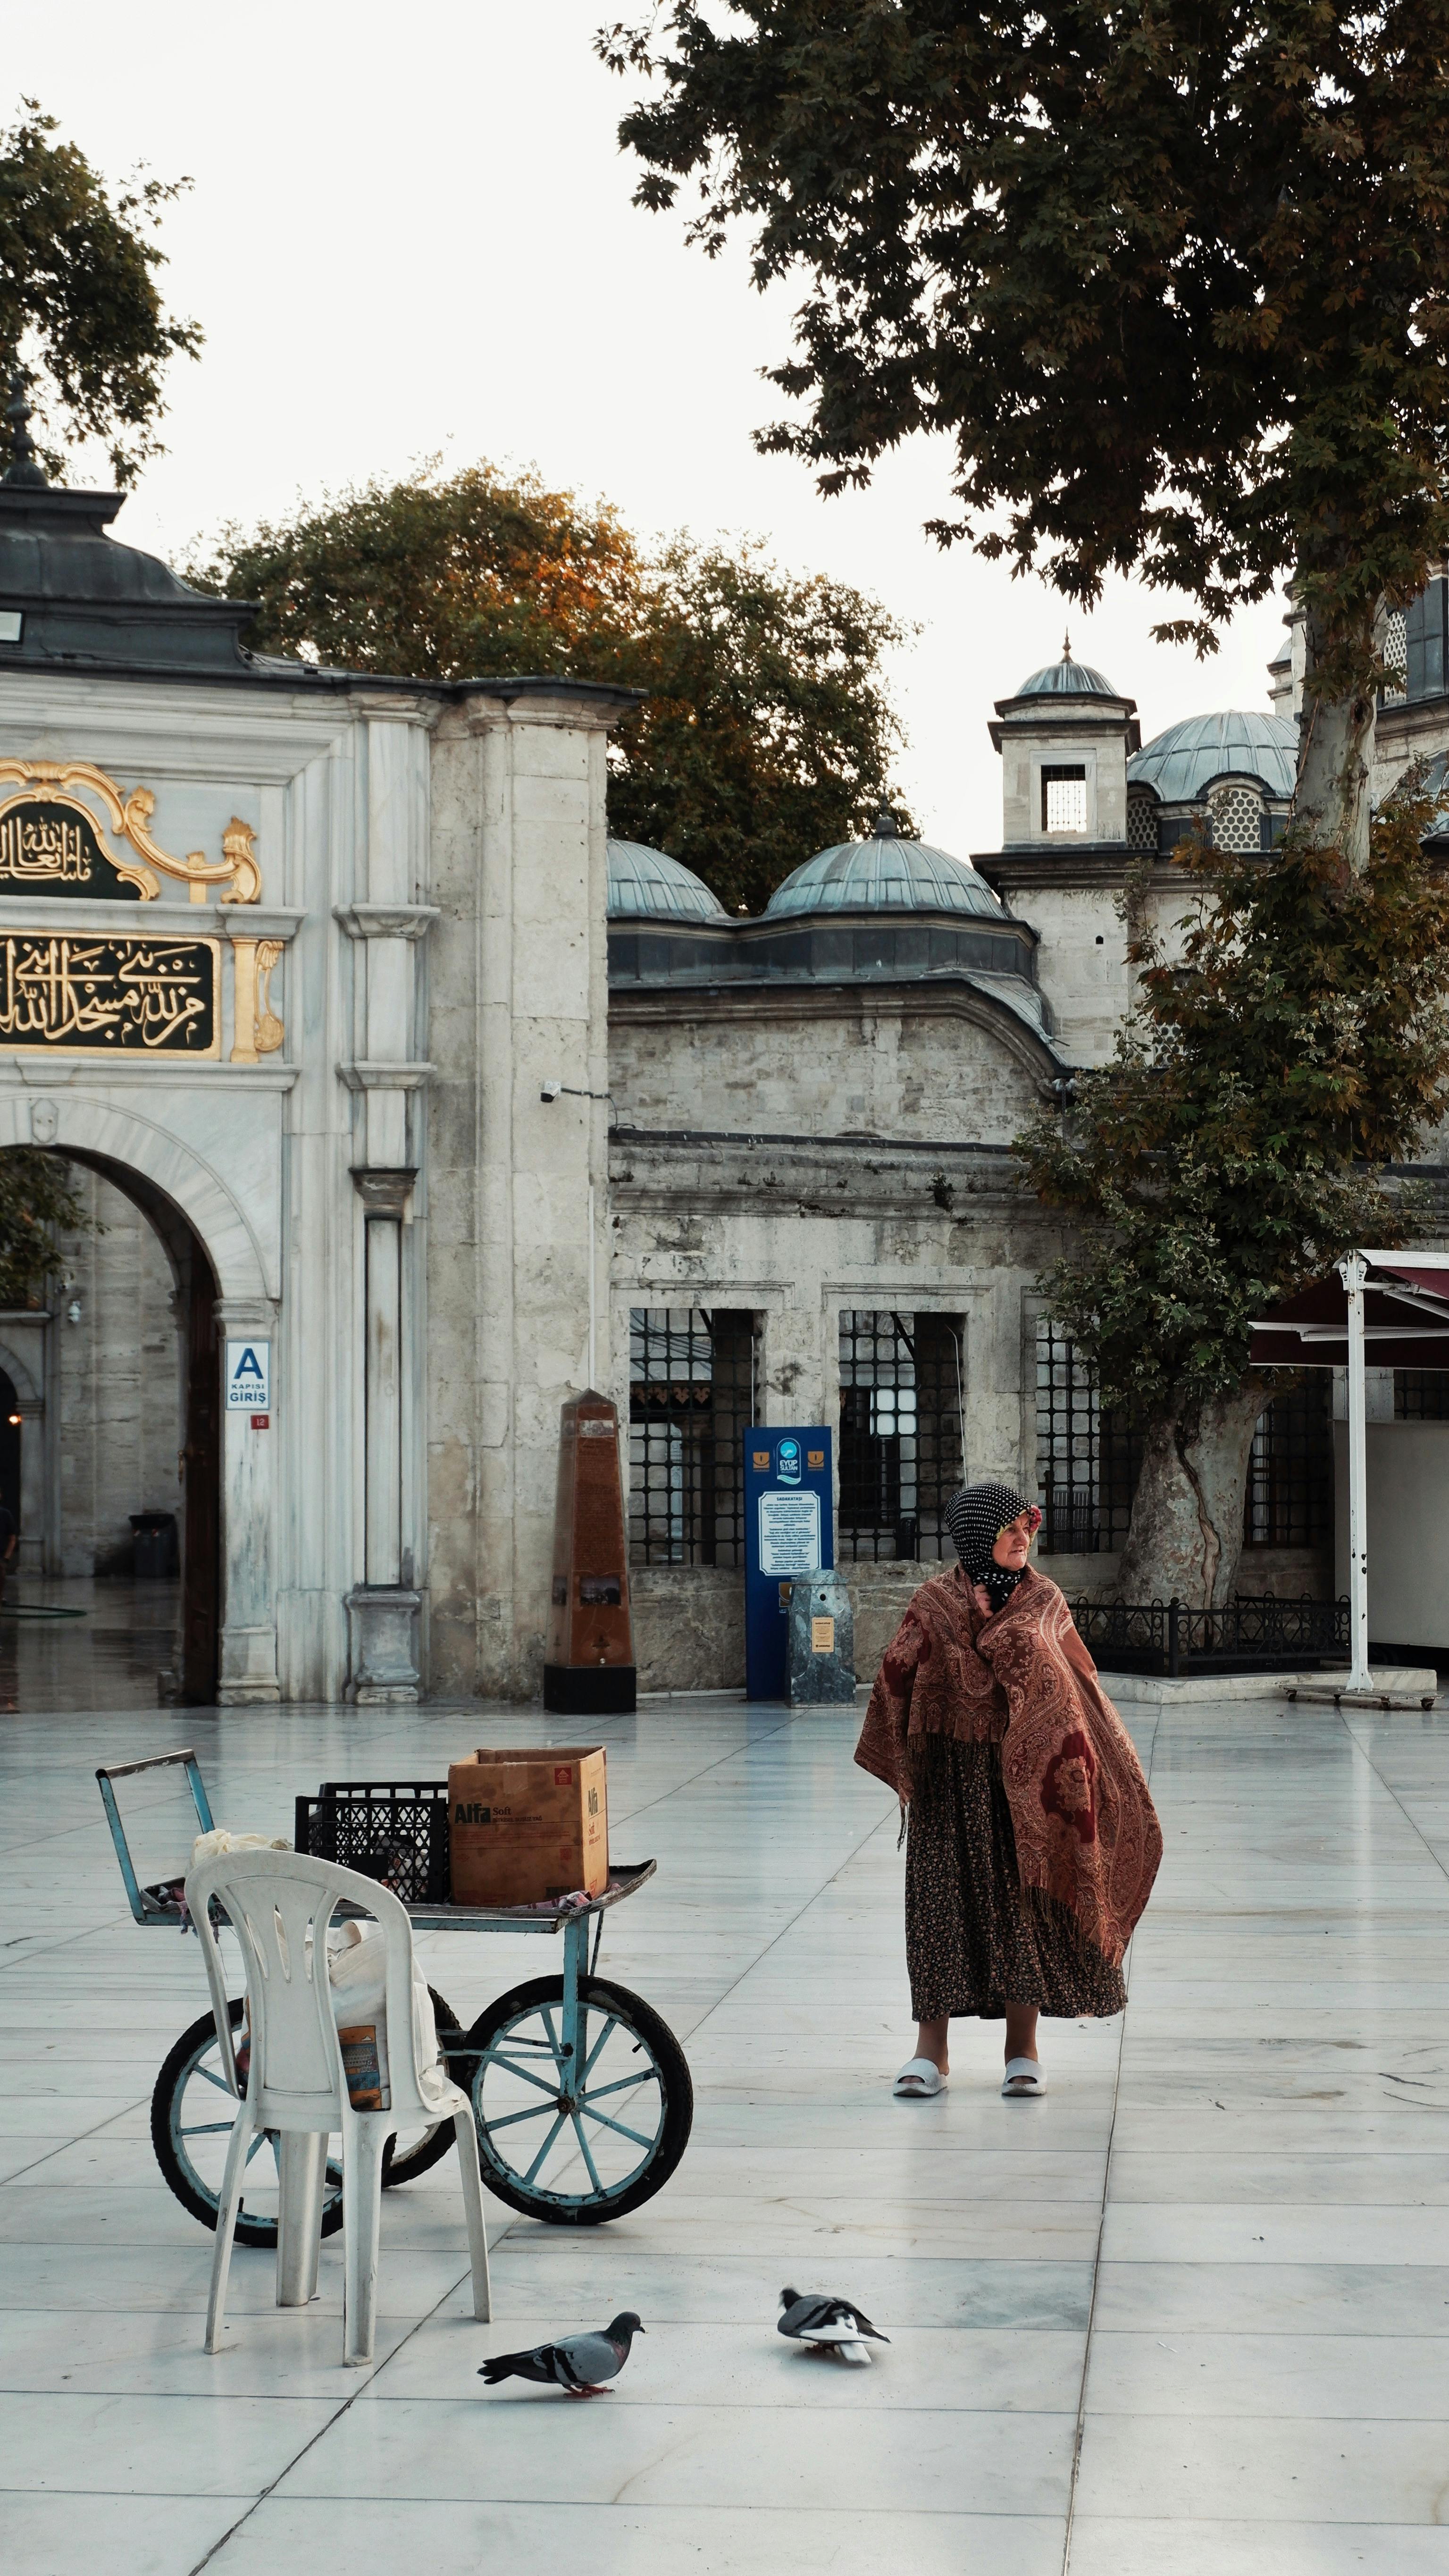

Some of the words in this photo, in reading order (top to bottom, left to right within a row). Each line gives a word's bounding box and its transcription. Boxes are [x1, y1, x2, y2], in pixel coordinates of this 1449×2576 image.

[234, 1348, 264, 1379] A
[230, 1390, 266, 1404] GİRİŞ
[256, 1418, 265, 1426] 12
[588, 1787, 598, 1817] Alfa
[455, 1803, 491, 1824] Alfa
[493, 1806, 511, 1816] Soft
